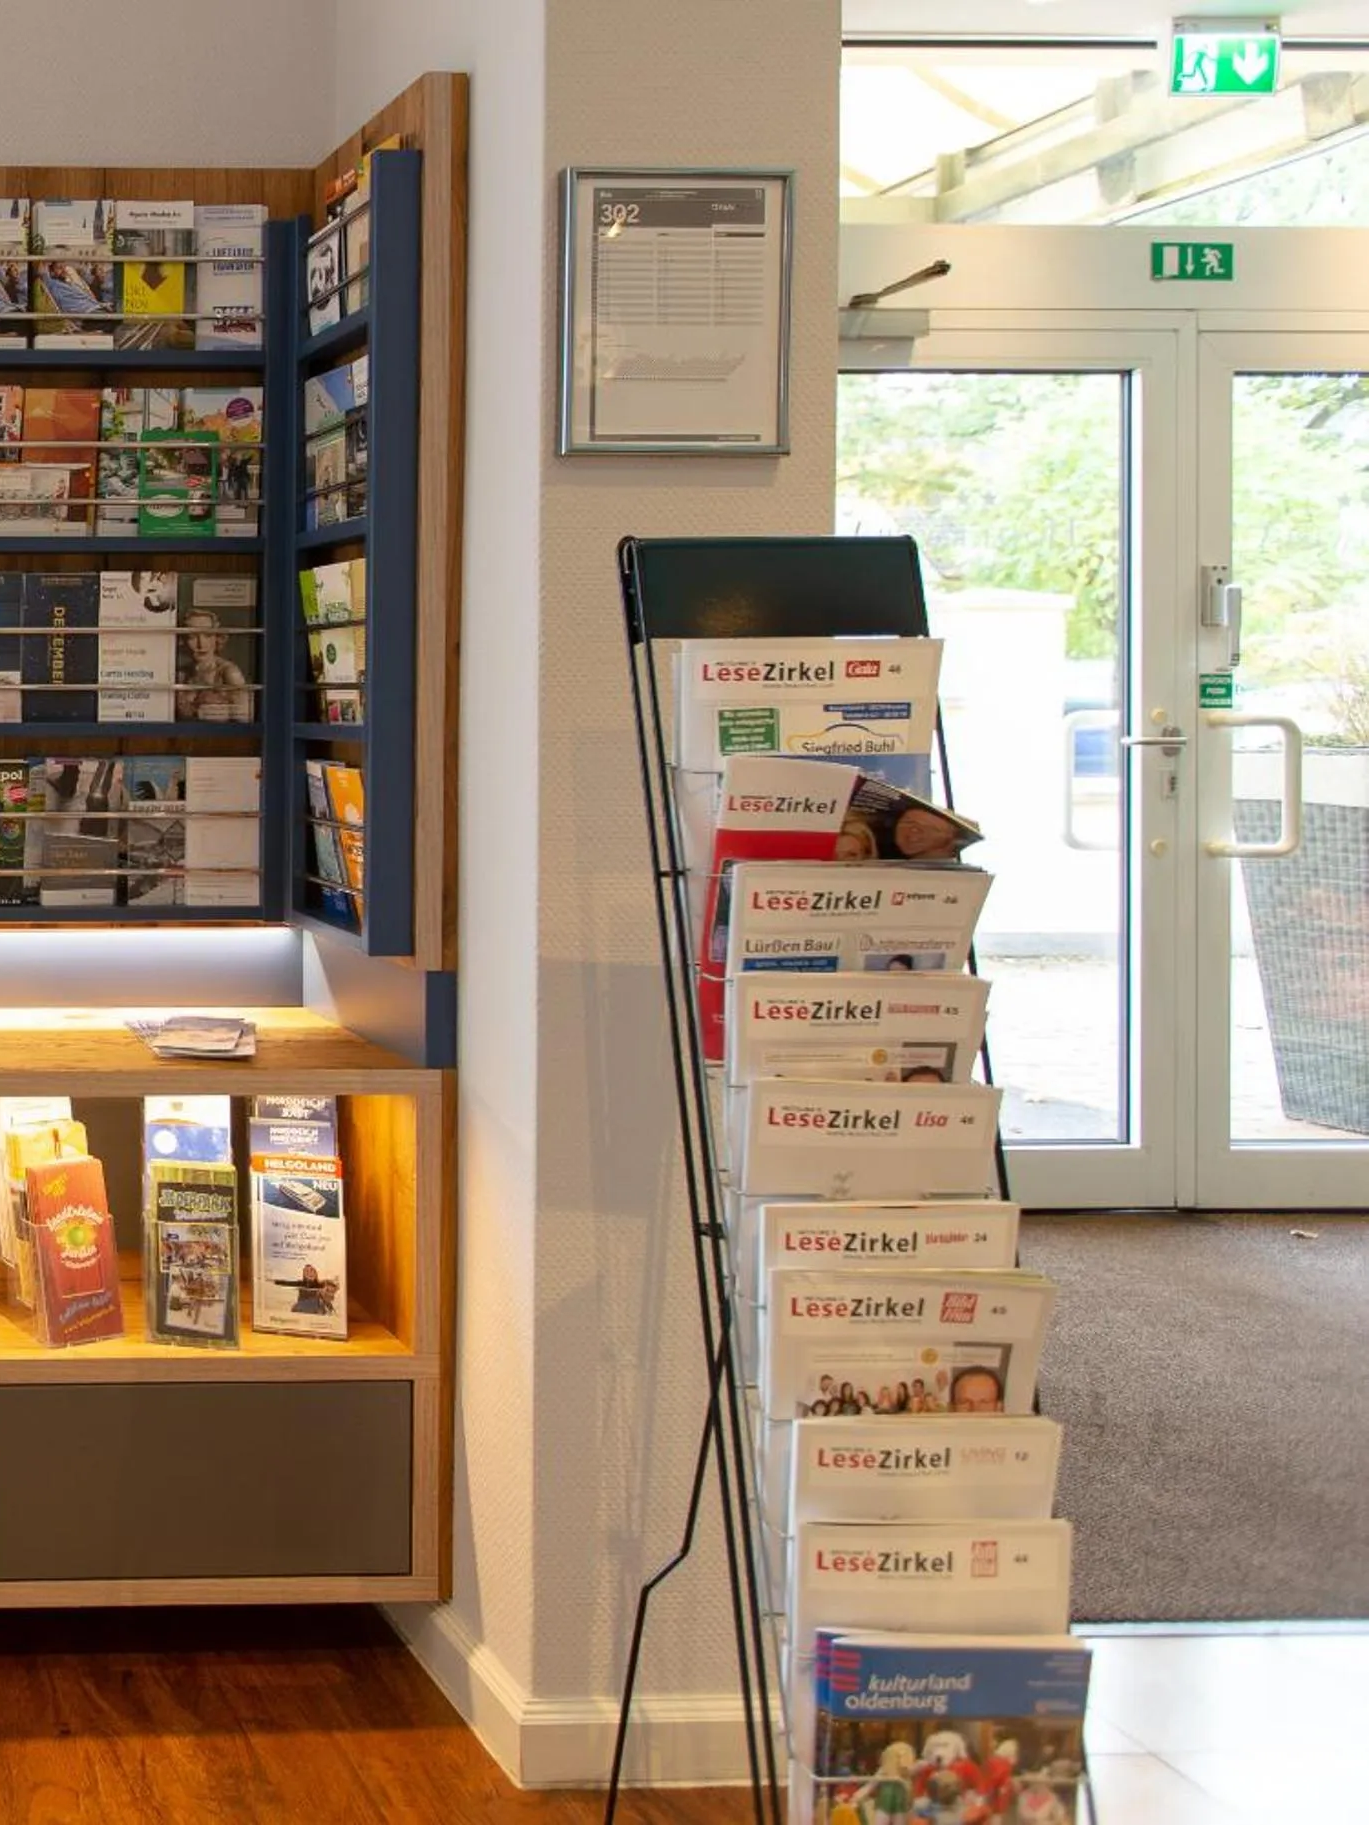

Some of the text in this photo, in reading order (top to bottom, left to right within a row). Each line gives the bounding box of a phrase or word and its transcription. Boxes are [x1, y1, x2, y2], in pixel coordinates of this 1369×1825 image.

[600, 203, 640, 224] 302
[53, 607, 65, 687] DEEMBE
[703, 661, 834, 682] LeseZirkel
[728, 796, 837, 815] LeseZirkel
[753, 890, 882, 911] LeseZirkel
[753, 1000, 882, 1020] LeseZirkel
[768, 1106, 901, 1129] LeseZirkel
[915, 1111, 949, 1127] Lisa
[264, 1159, 337, 1173] HELGOLAND
[785, 1231, 918, 1253] LeseZirkel
[791, 1297, 925, 1318] LeseZirkel
[818, 1447, 951, 1469] LeseZirkel
[817, 1550, 953, 1573] LeseZirkel
[867, 1673, 972, 1692] kulturland
[845, 1693, 949, 1713] oldenburg
